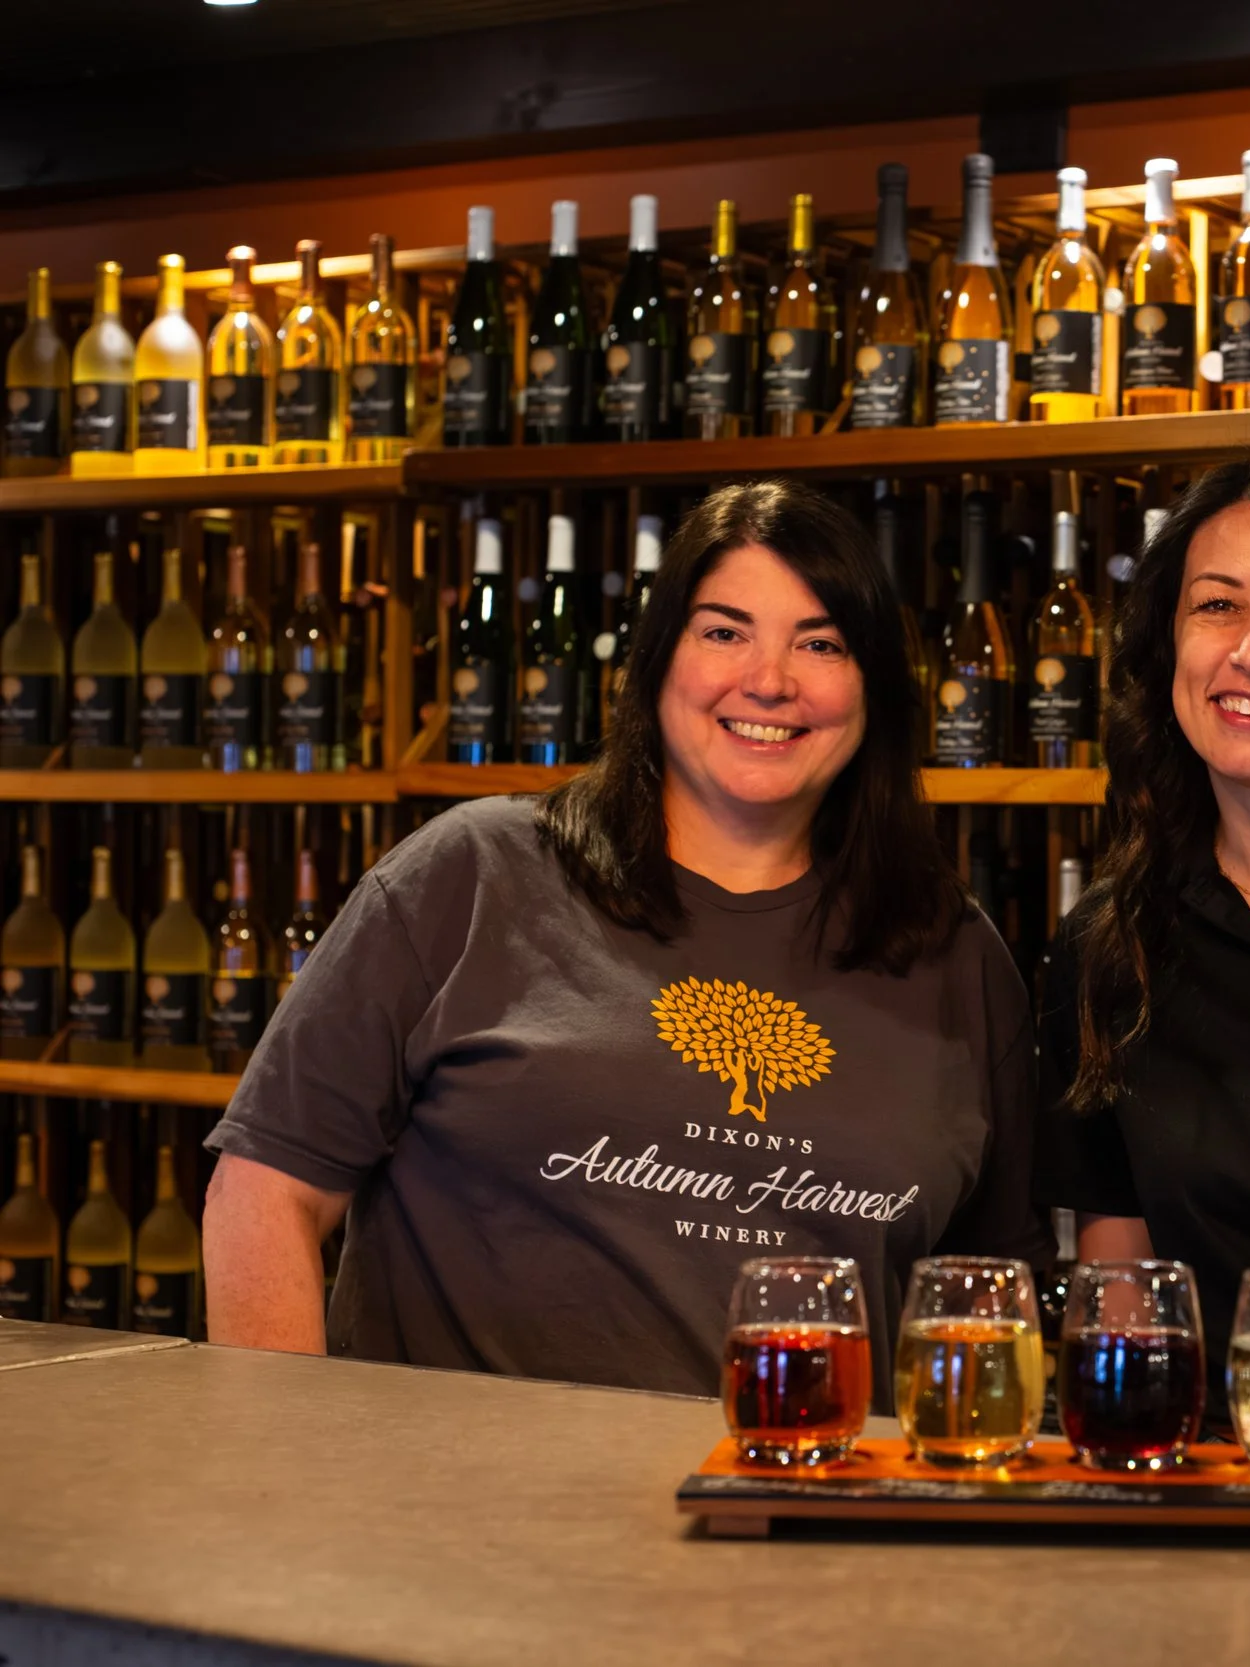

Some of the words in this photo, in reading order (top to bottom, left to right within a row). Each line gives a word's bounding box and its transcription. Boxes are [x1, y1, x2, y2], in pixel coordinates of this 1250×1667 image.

[684, 1122, 814, 1155] DIXON'S
[539, 1135, 735, 1201] Autumn
[735, 1165, 920, 1222] Harvest
[674, 1219, 788, 1247] WINERY
